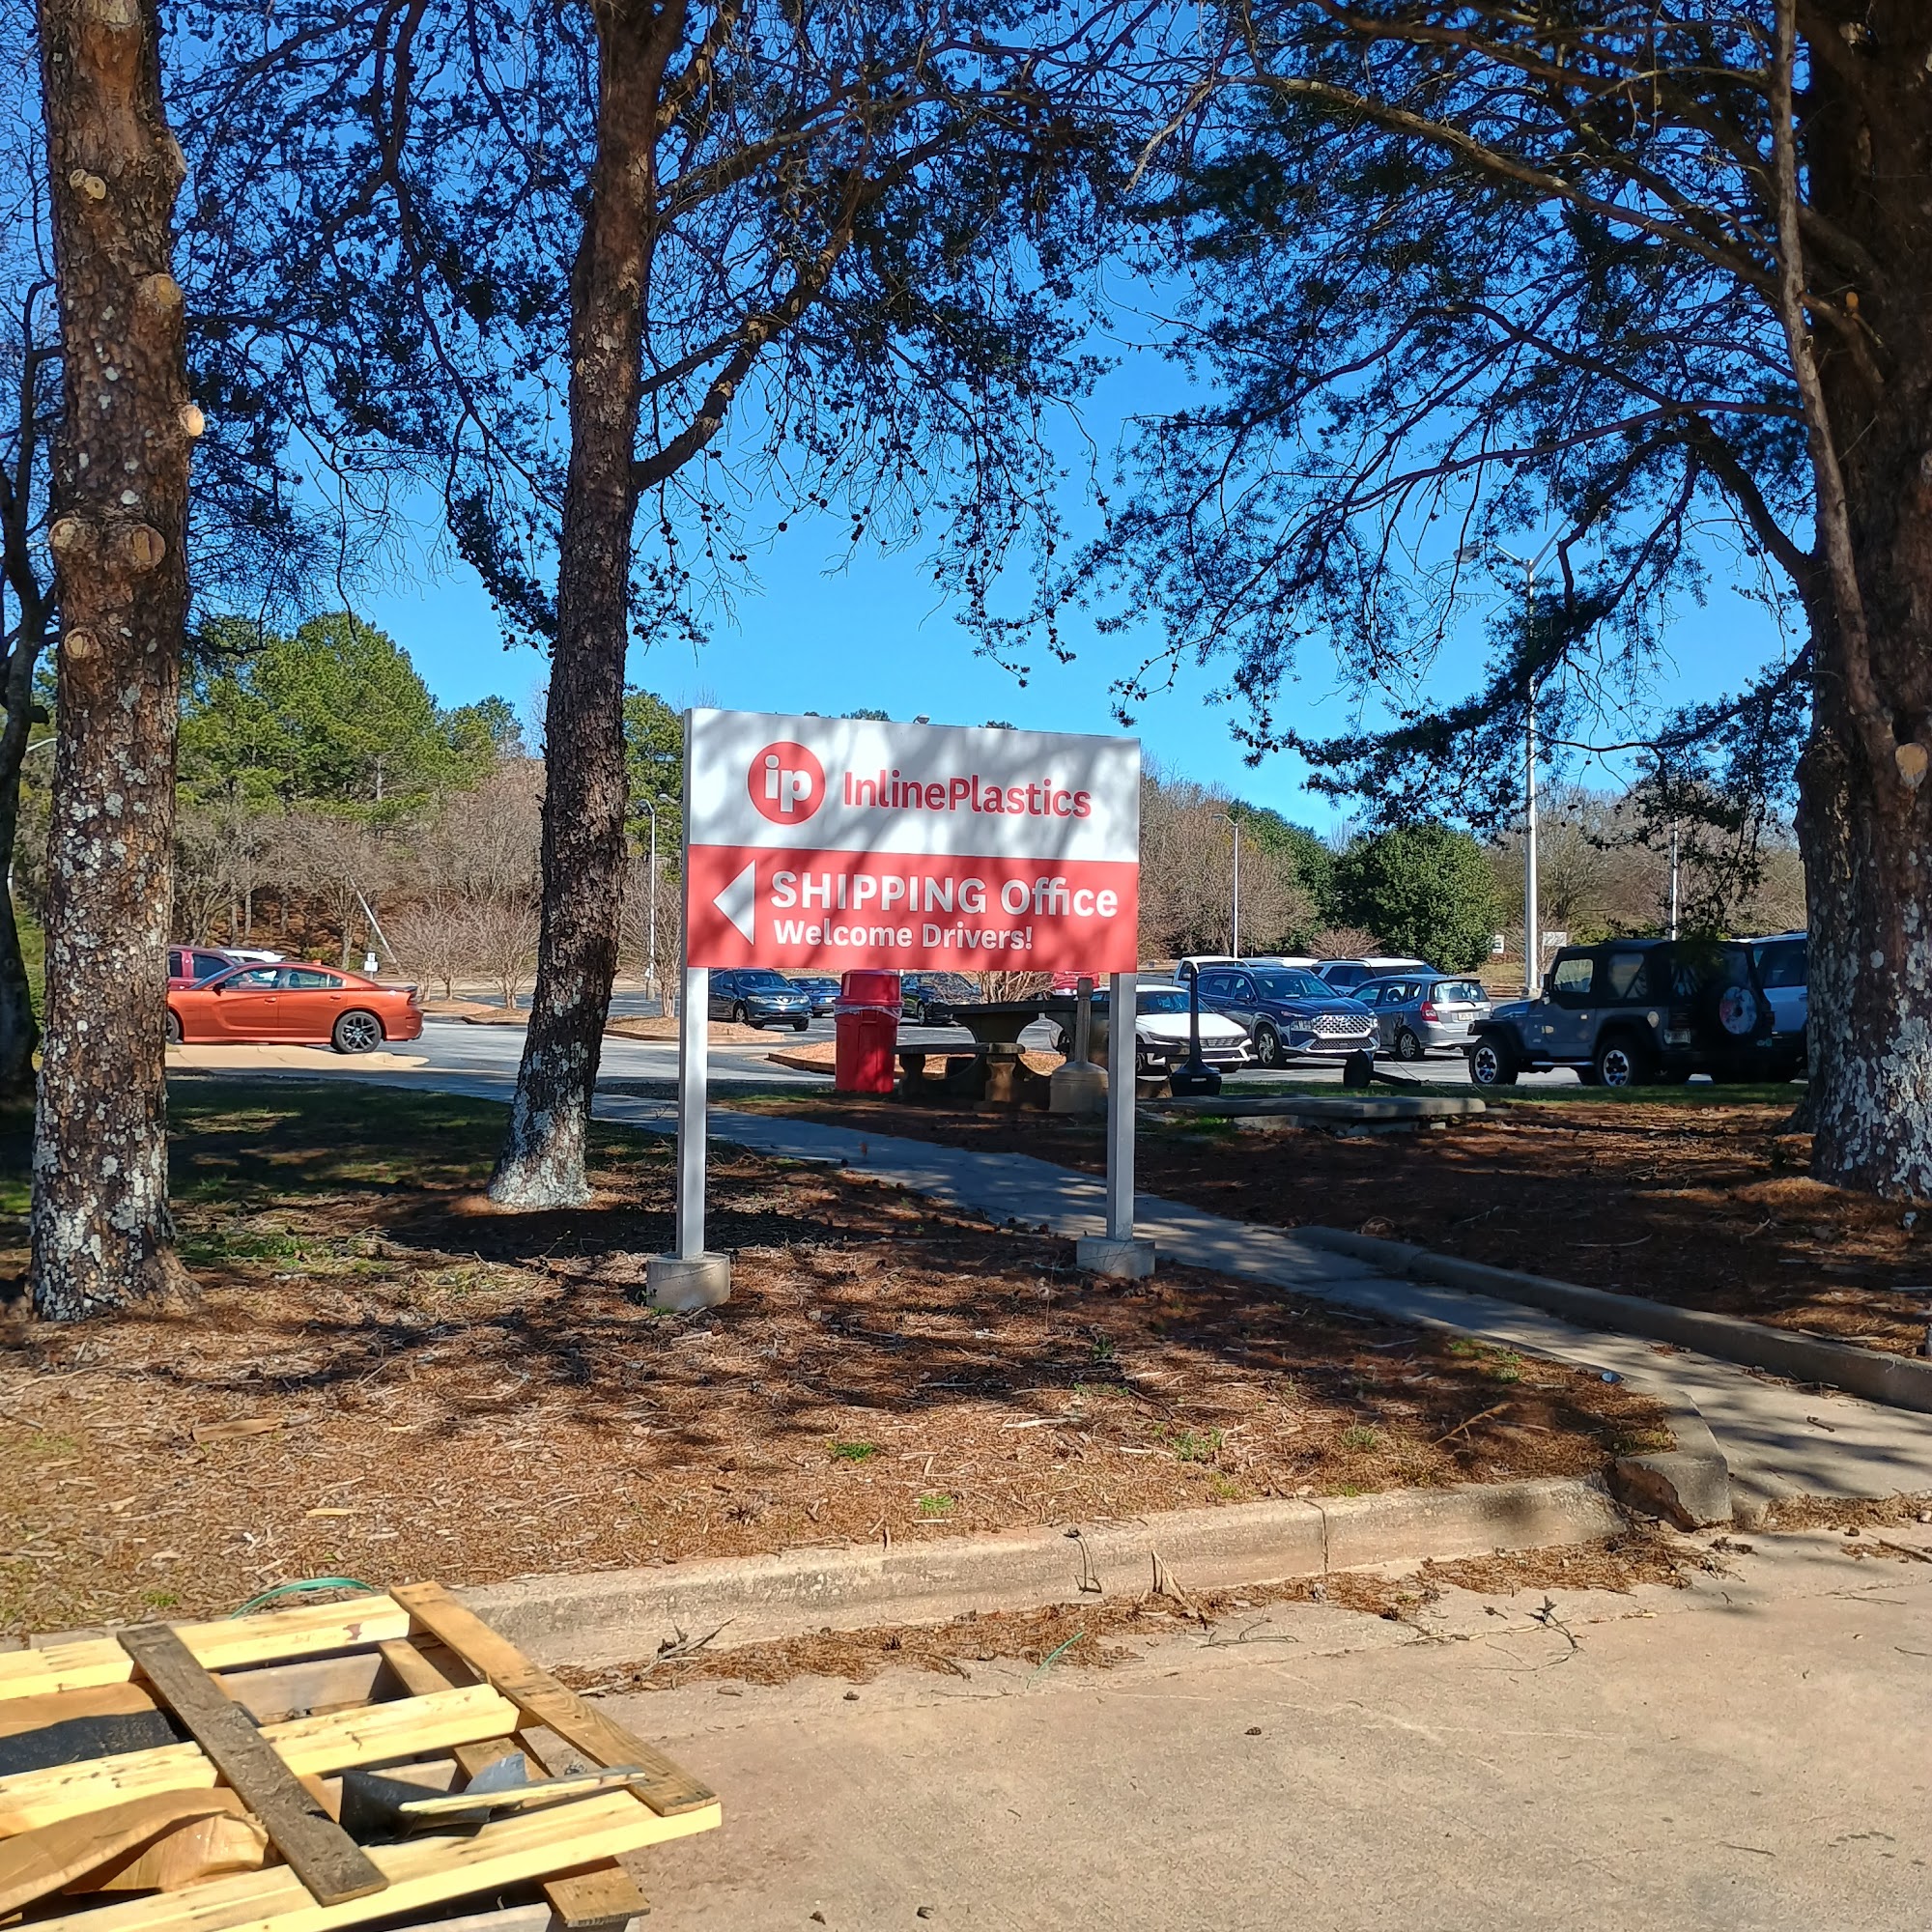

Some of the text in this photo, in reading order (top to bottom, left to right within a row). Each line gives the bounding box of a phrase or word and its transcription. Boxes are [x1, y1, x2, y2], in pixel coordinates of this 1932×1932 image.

[764, 754, 812, 812] ip
[844, 770, 1093, 817] InlinePlastics
[771, 870, 1119, 918] SHIPPING Office
[774, 918, 1033, 951] Welcome Drivers!
